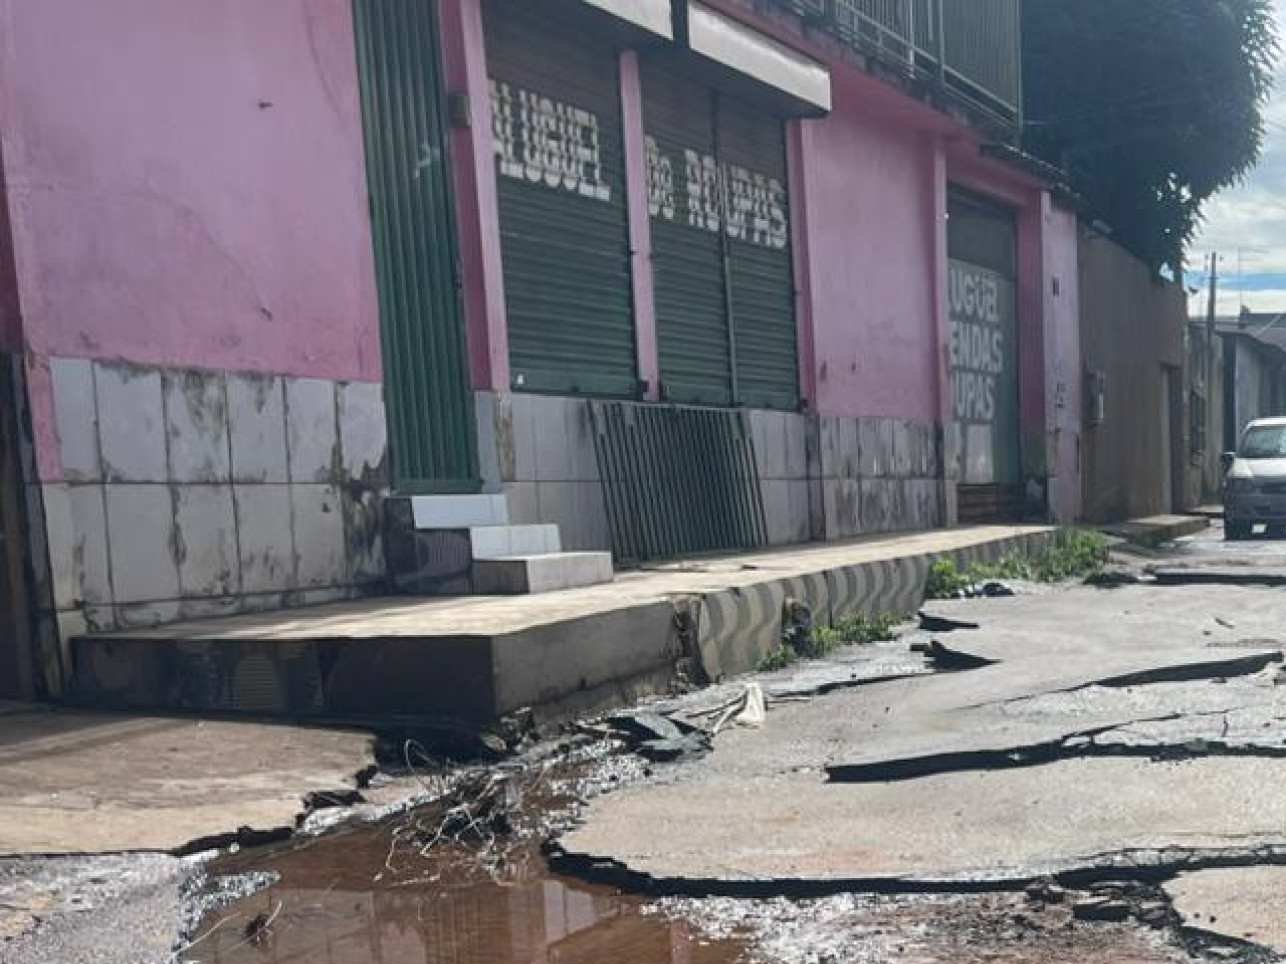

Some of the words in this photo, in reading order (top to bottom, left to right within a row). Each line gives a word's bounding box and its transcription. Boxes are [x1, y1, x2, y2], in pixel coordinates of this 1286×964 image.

[684, 149, 787, 249] ROUPAS
[950, 268, 999, 322] UGUEL
[950, 320, 1003, 374] ENDAS
[953, 370, 995, 420] UPAS
